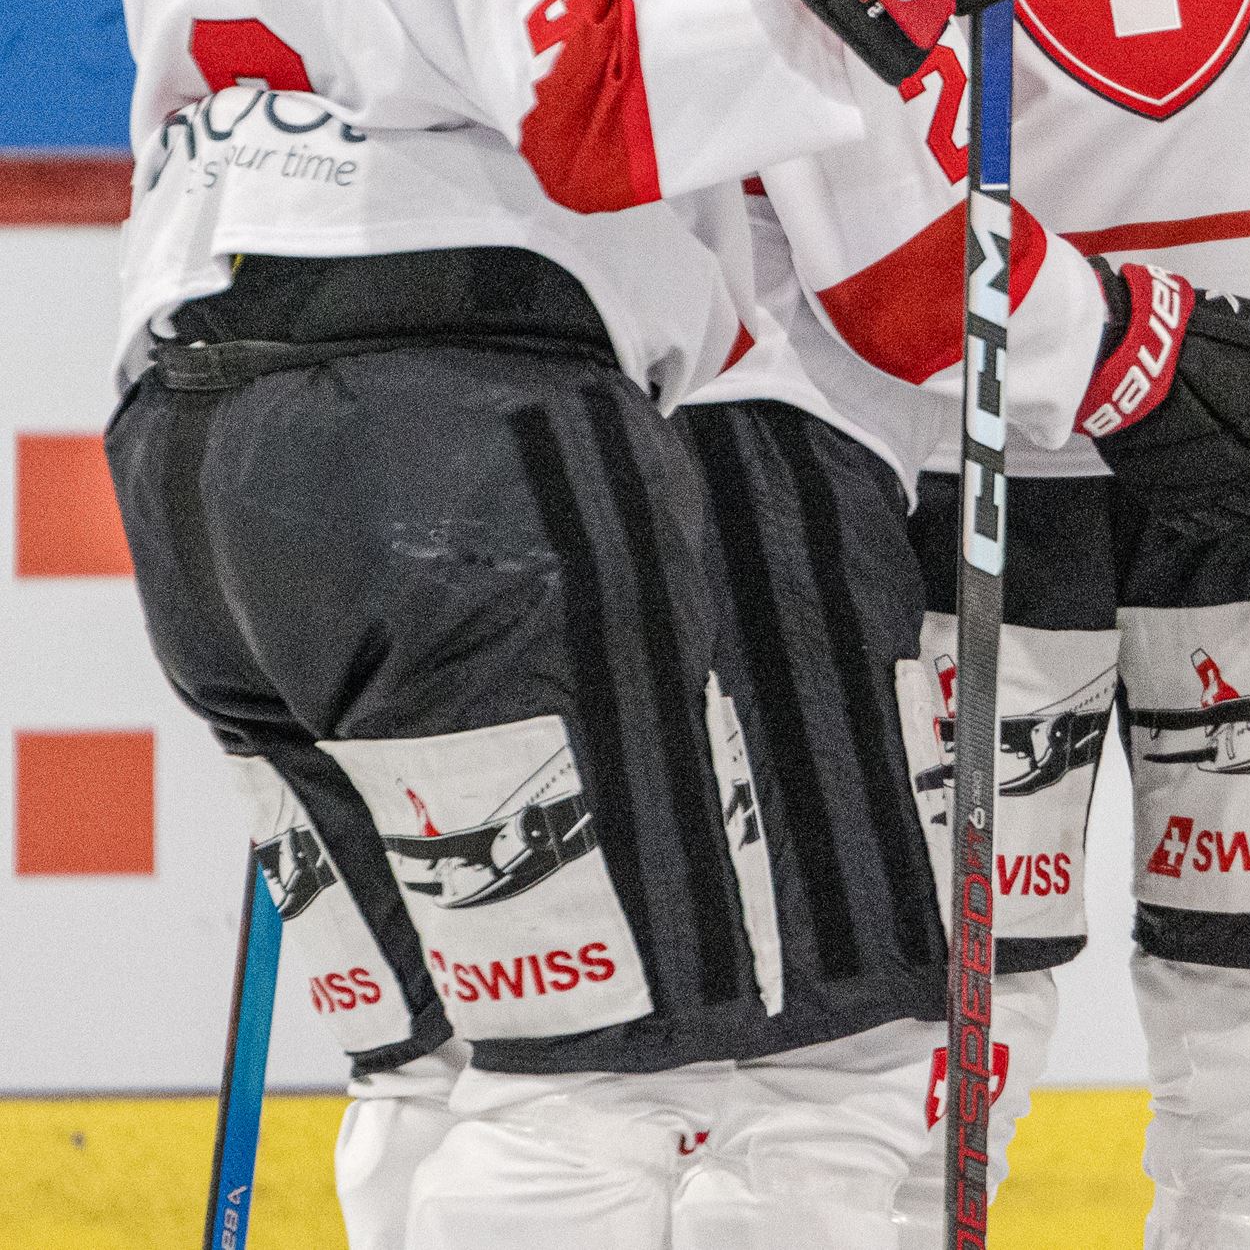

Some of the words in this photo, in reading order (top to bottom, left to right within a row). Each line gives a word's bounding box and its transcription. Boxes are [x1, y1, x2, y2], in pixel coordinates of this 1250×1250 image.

[281, 144, 358, 187] time
[962, 190, 1012, 577] CCM
[1082, 264, 1181, 438] BAUER
[452, 941, 617, 1003] SWISS
